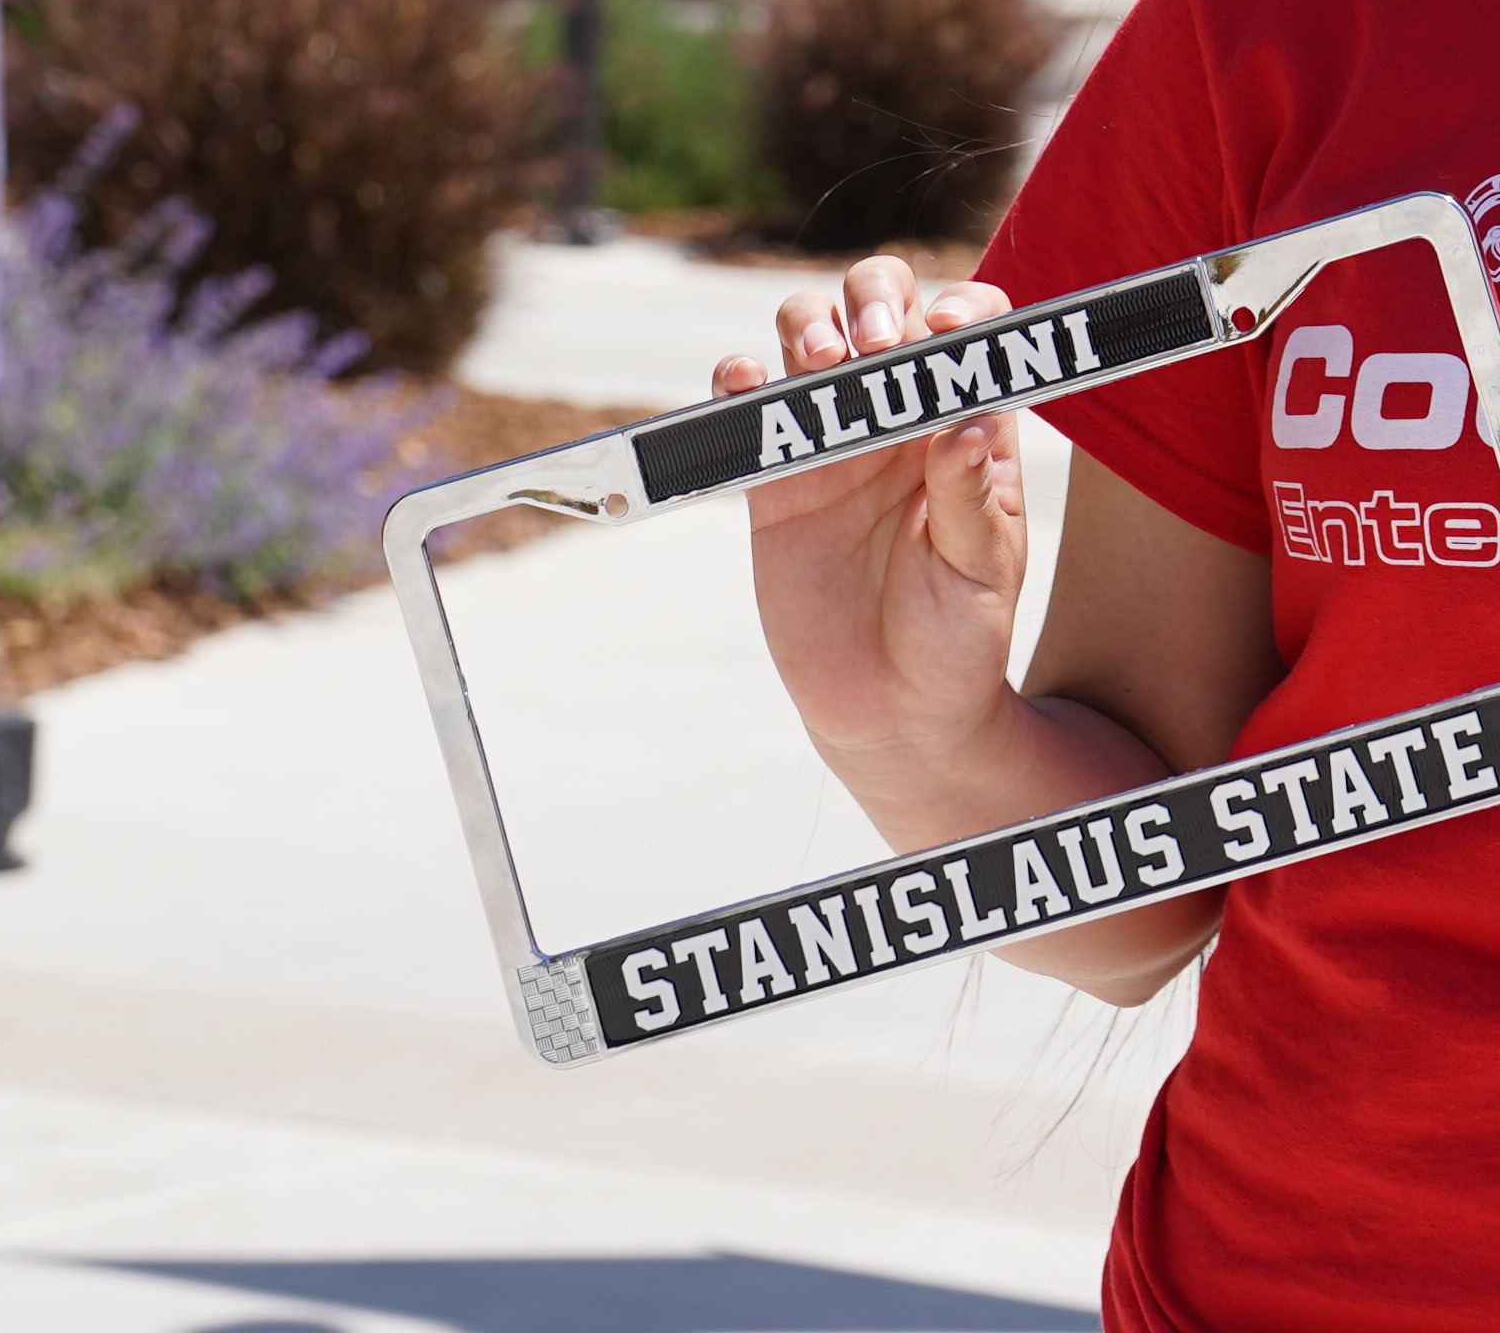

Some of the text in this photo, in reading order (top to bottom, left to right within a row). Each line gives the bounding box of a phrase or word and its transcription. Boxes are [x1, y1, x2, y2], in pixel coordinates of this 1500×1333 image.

[759, 309, 1101, 468] ALUMNI
[621, 711, 1499, 1031] STANISLAUS STATE
